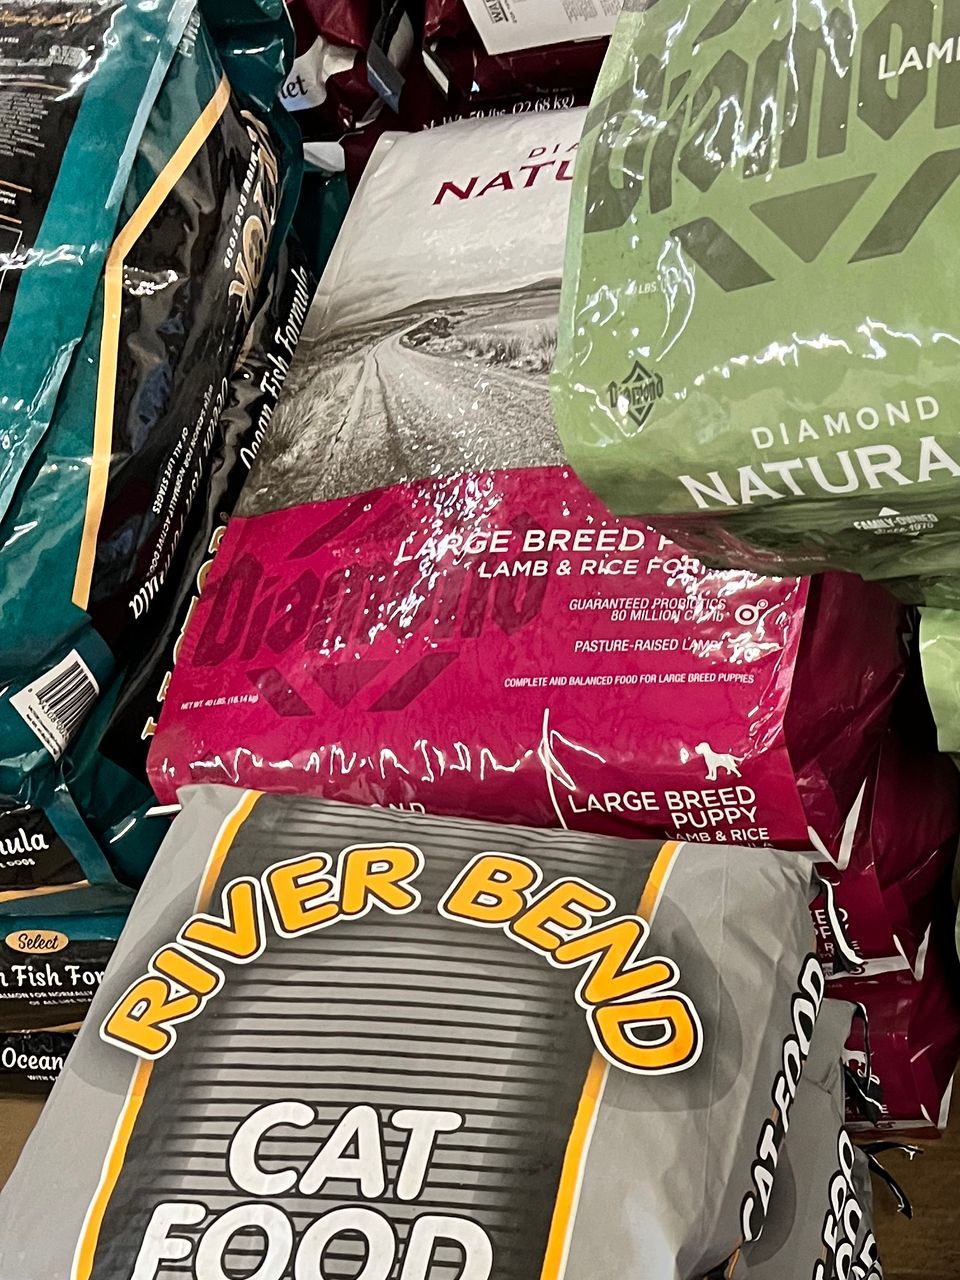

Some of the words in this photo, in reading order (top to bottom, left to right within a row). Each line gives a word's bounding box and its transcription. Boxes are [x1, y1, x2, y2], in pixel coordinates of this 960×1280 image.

[751, 396, 941, 449] DIAMOND
[174, 441, 184, 458] ALL
[165, 459, 177, 480] LIFE
[152, 480, 168, 515] STAGES
[523, 529, 645, 552] BREED
[478, 560, 548, 579] LAMB
[556, 562, 571, 576] &
[580, 559, 638, 575] RICE
[569, 598, 650, 611] GUARANTEED
[611, 609, 627, 621] 80
[575, 639, 678, 652] PASTURE-RAISED
[504, 677, 548, 688] COMPLETE
[549, 676, 567, 686] AND
[569, 675, 613, 686] BALANCED
[614, 674, 638, 685] FOOD
[640, 673, 657, 684] FOR
[658, 673, 687, 684] LARGE
[688, 673, 715, 683] BREED
[717, 673, 755, 684] PUPPIES
[568, 791, 660, 813] LARGE
[664, 785, 756, 811] BREED
[671, 806, 757, 830] PUPPY
[715, 830, 727, 841] &
[731, 827, 769, 841] RICE
[17, 933, 60, 950] Select
[99, 842, 425, 1060] RIVER
[437, 850, 704, 1075] BEND
[11, 963, 63, 987] Fish
[2, 1047, 64, 1070] Ocean
[739, 1124, 780, 1243] CAT
[774, 952, 825, 1136] FOOD
[226, 1099, 464, 1201] CAT
